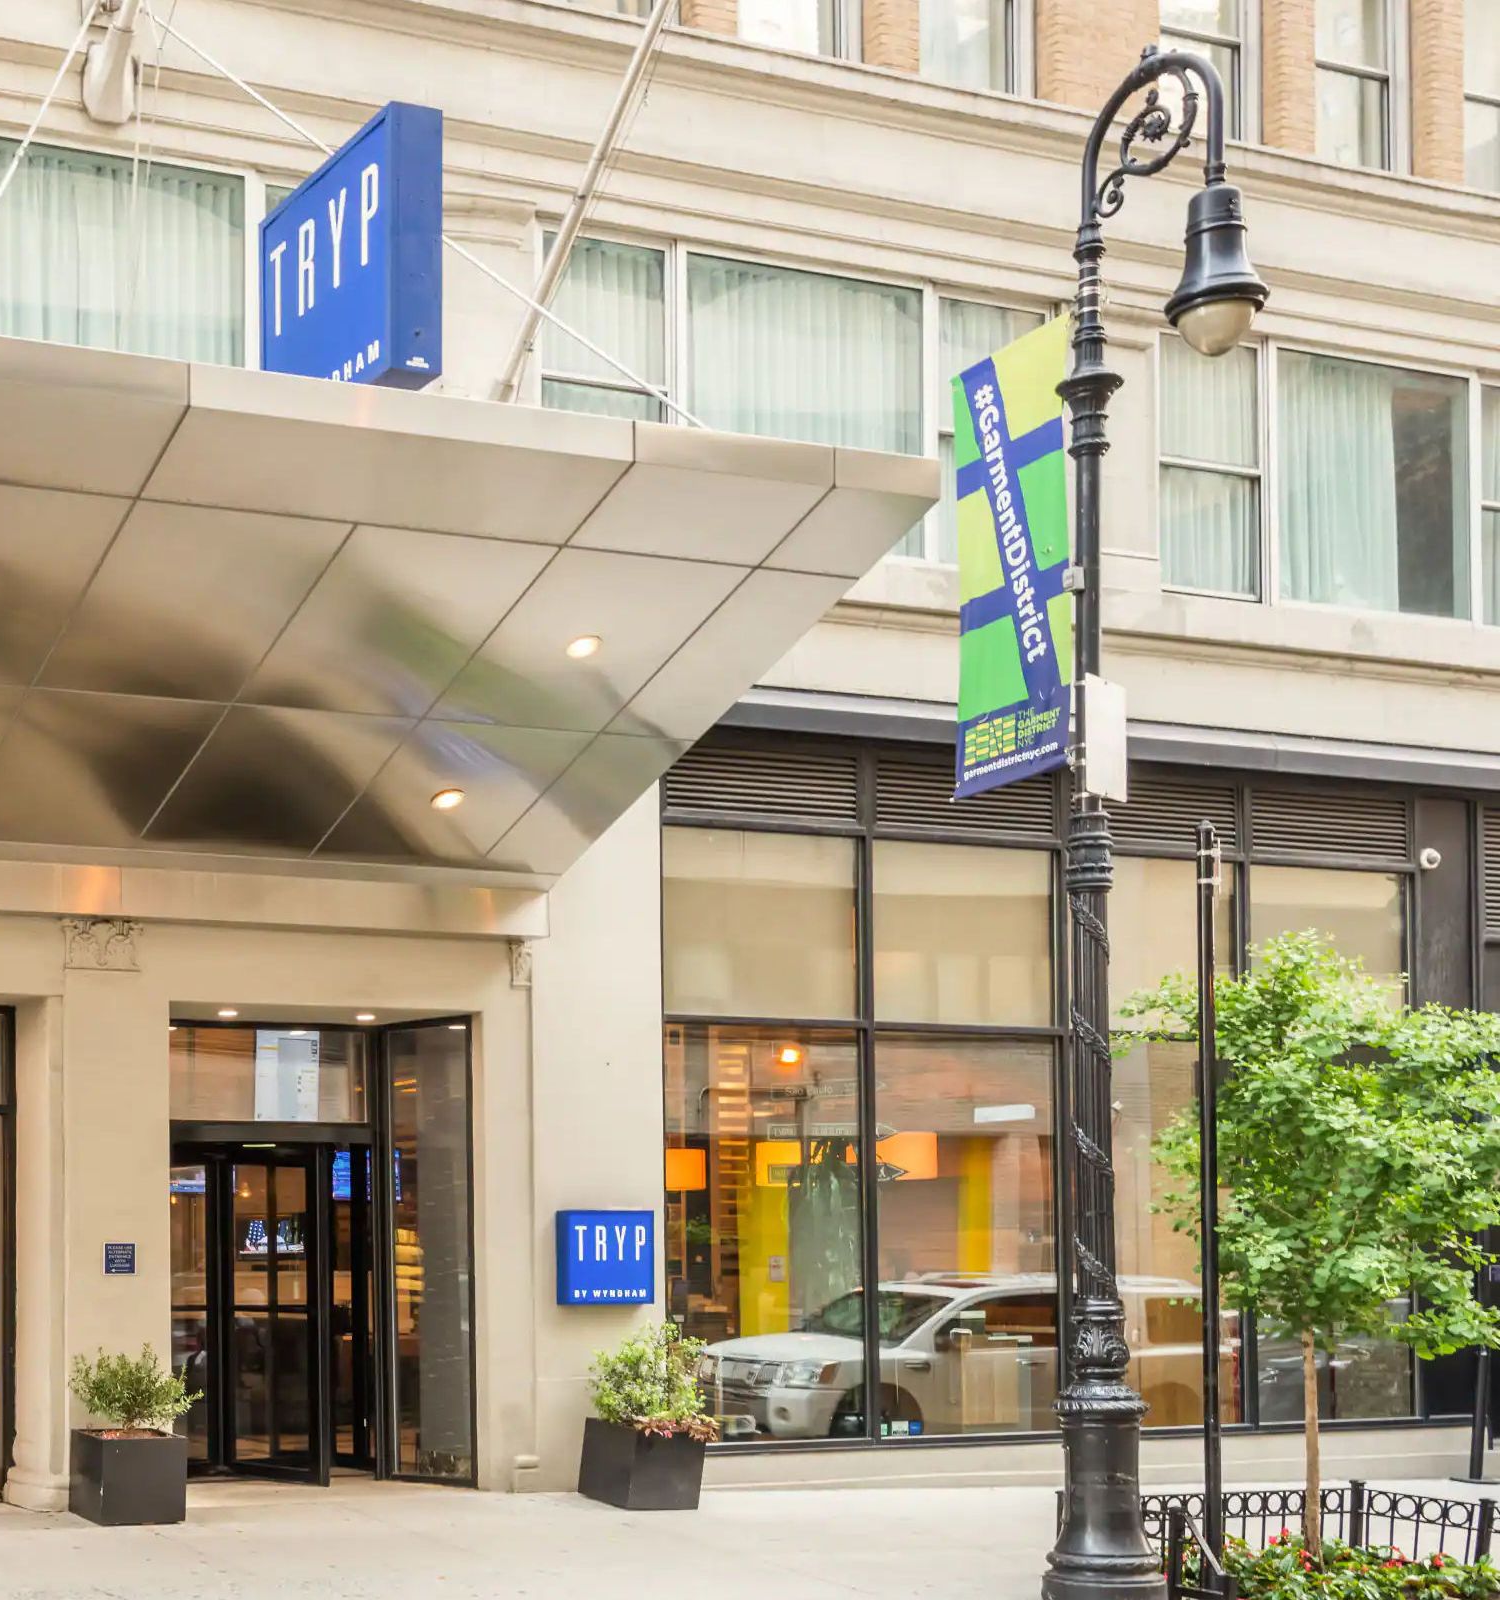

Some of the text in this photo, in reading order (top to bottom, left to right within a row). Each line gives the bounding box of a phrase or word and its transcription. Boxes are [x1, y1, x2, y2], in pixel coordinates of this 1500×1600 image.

[270, 162, 379, 336] TRYP
[973, 383, 1048, 664] #GarmentDistrict
[1017, 707, 1035, 720] THE
[1017, 707, 1061, 730] GARMENT
[1017, 719, 1057, 740] DISTRICT
[1017, 735, 1035, 749] NYC
[963, 741, 1059, 781] garmentdistrictnyc.com
[574, 1225, 646, 1261] TRYP
[574, 1289, 647, 1298] BY WYNDHAM
